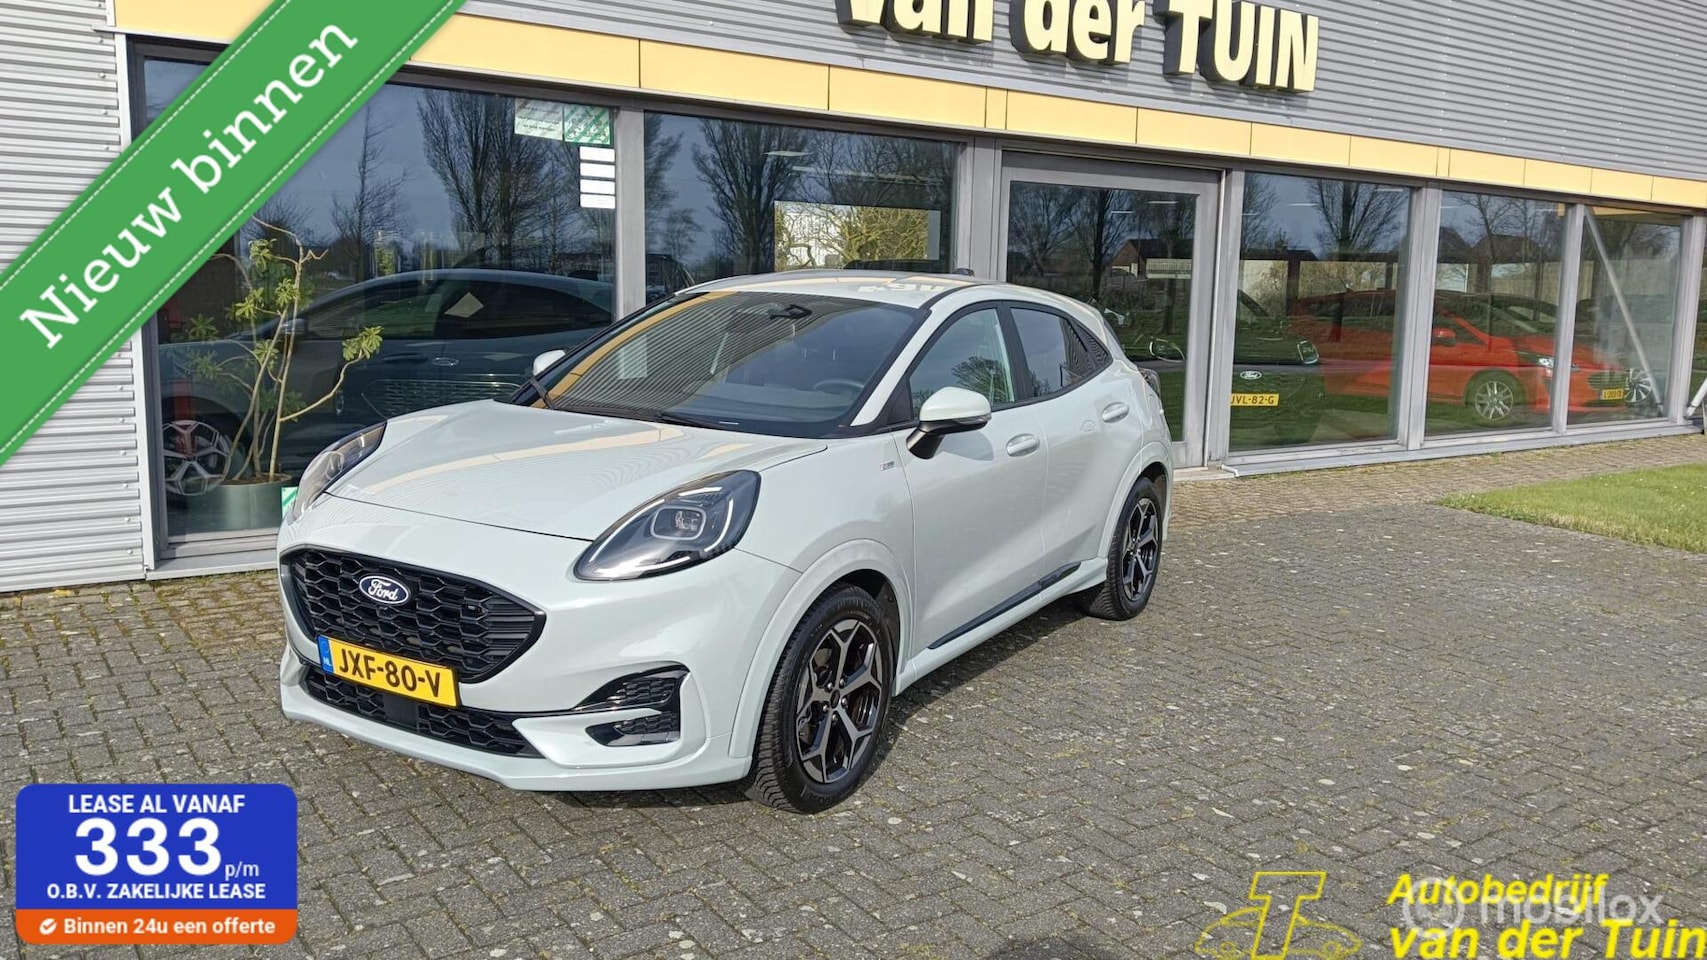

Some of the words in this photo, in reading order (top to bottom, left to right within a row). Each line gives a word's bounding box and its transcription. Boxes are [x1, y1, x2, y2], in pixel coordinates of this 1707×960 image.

[1023, 0, 1146, 64] der
[1166, 0, 1320, 92] TUIN
[1230, 395, 1275, 405] JVL-82-G
[366, 577, 400, 602] Ford
[338, 648, 441, 698] JXF-80-V
